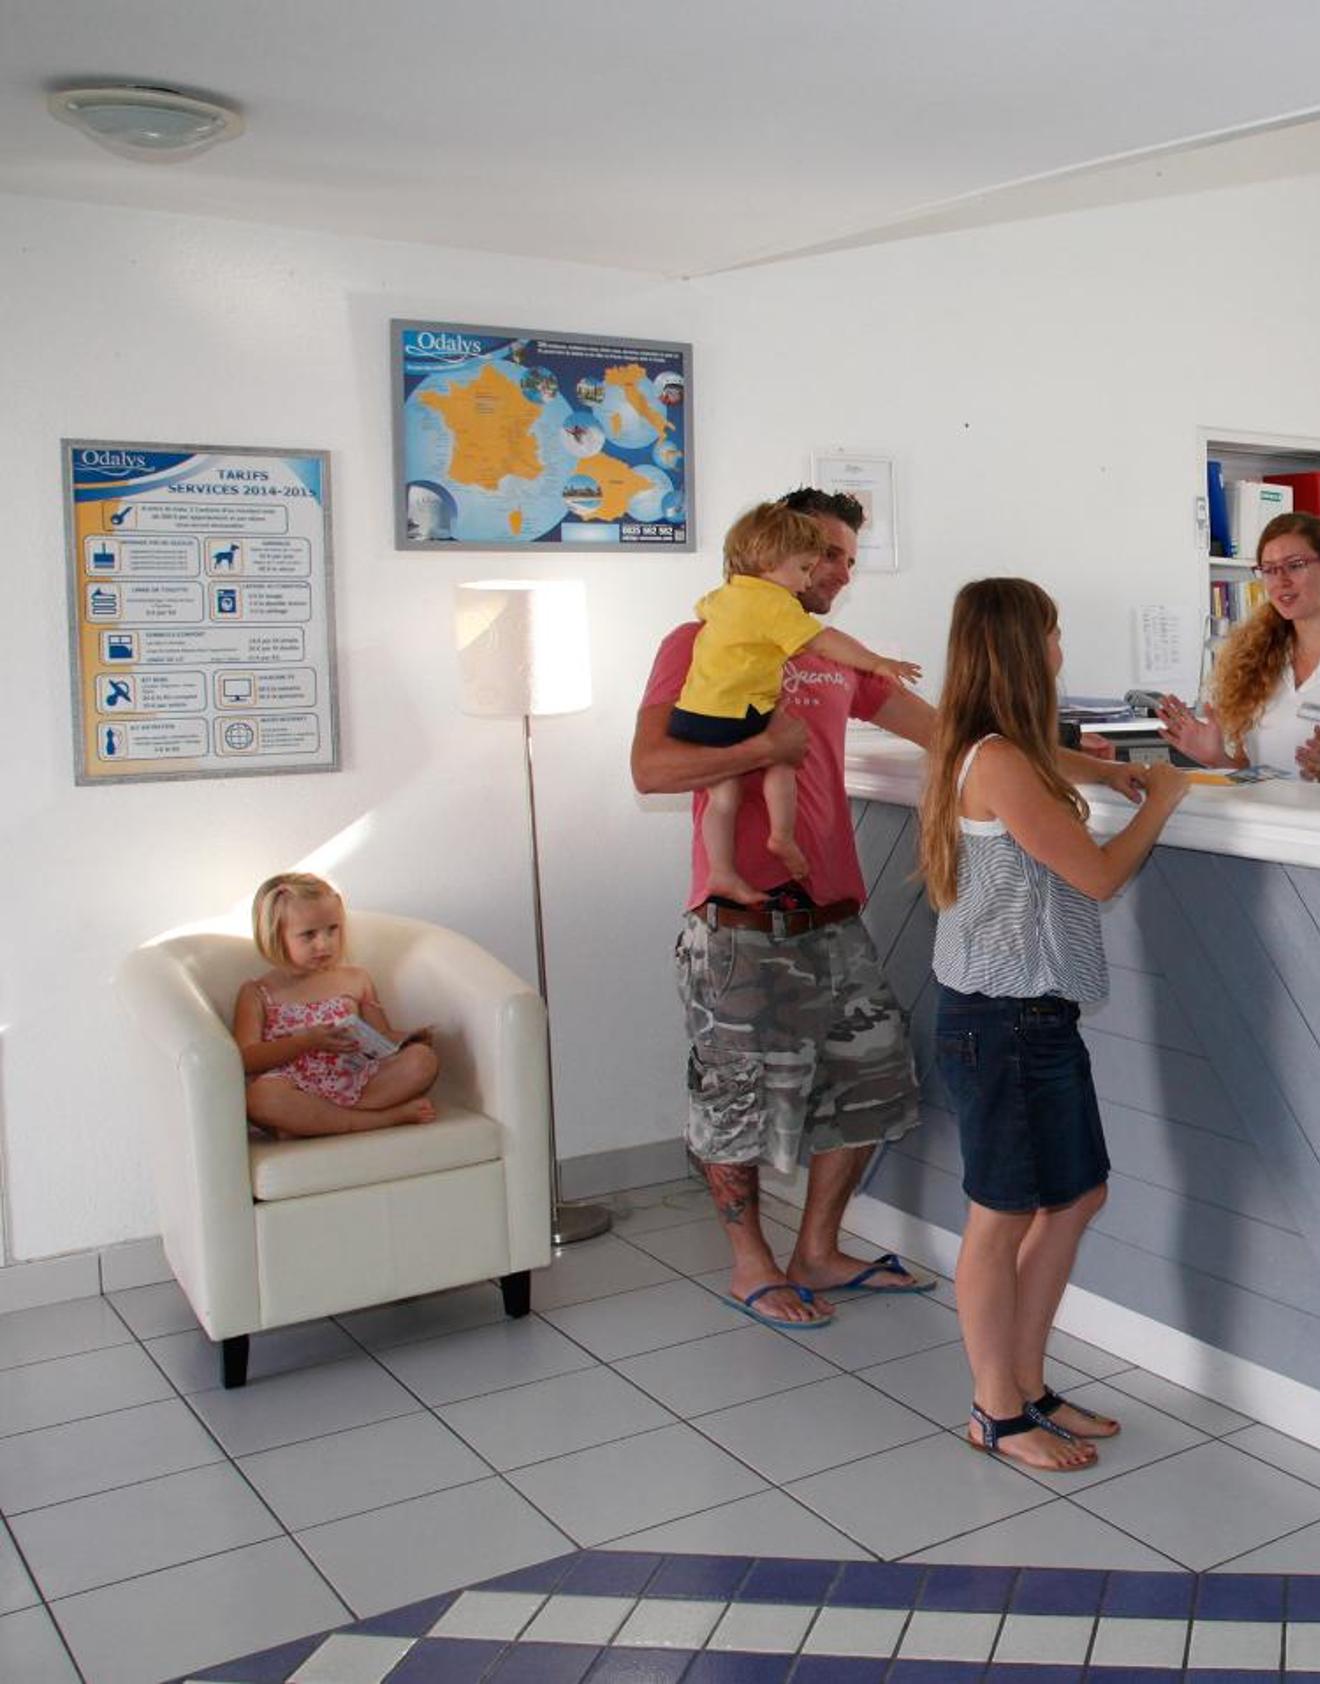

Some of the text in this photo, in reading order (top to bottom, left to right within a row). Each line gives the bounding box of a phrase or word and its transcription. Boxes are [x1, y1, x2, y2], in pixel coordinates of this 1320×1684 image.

[417, 332, 482, 355] Odalys
[81, 450, 147, 468] Odalys
[217, 468, 270, 481] TARIFS
[168, 483, 318, 497] SERVICES 2014-2015
